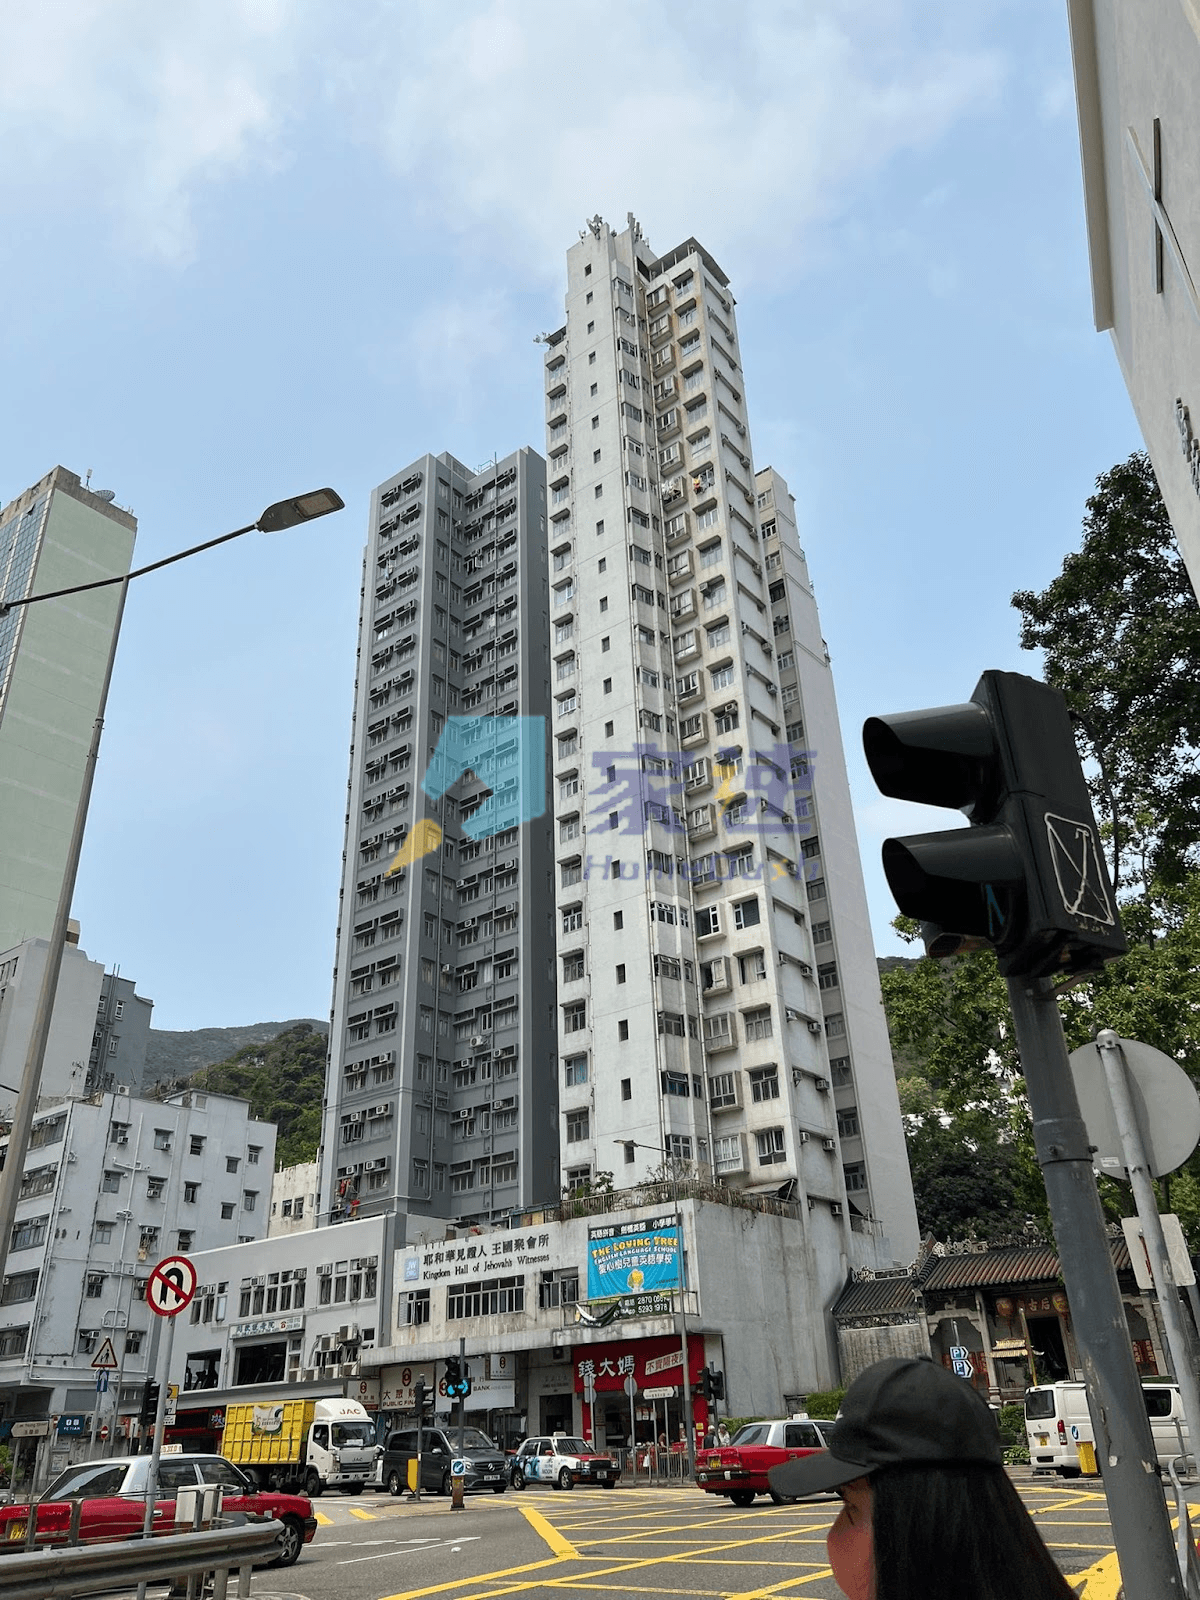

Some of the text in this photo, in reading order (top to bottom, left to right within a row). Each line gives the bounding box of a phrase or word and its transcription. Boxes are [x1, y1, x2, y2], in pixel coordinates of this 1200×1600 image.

[423, 1233, 549, 1266] 耶和華見證人 王國聚會所
[592, 1236, 679, 1258] THE LOVING TREE
[594, 1245, 677, 1265] ENGLISH LANGUAGE SCHOOL
[423, 1254, 550, 1281] Kingdom Hall of Jehovah's Witnesses
[637, 1295, 652, 1305] 2870
[637, 1304, 653, 1314] 5293
[654, 1303, 668, 1312] 1978
[578, 1355, 635, 1378] 錢大媽
[473, 1384, 490, 1392] BANK
